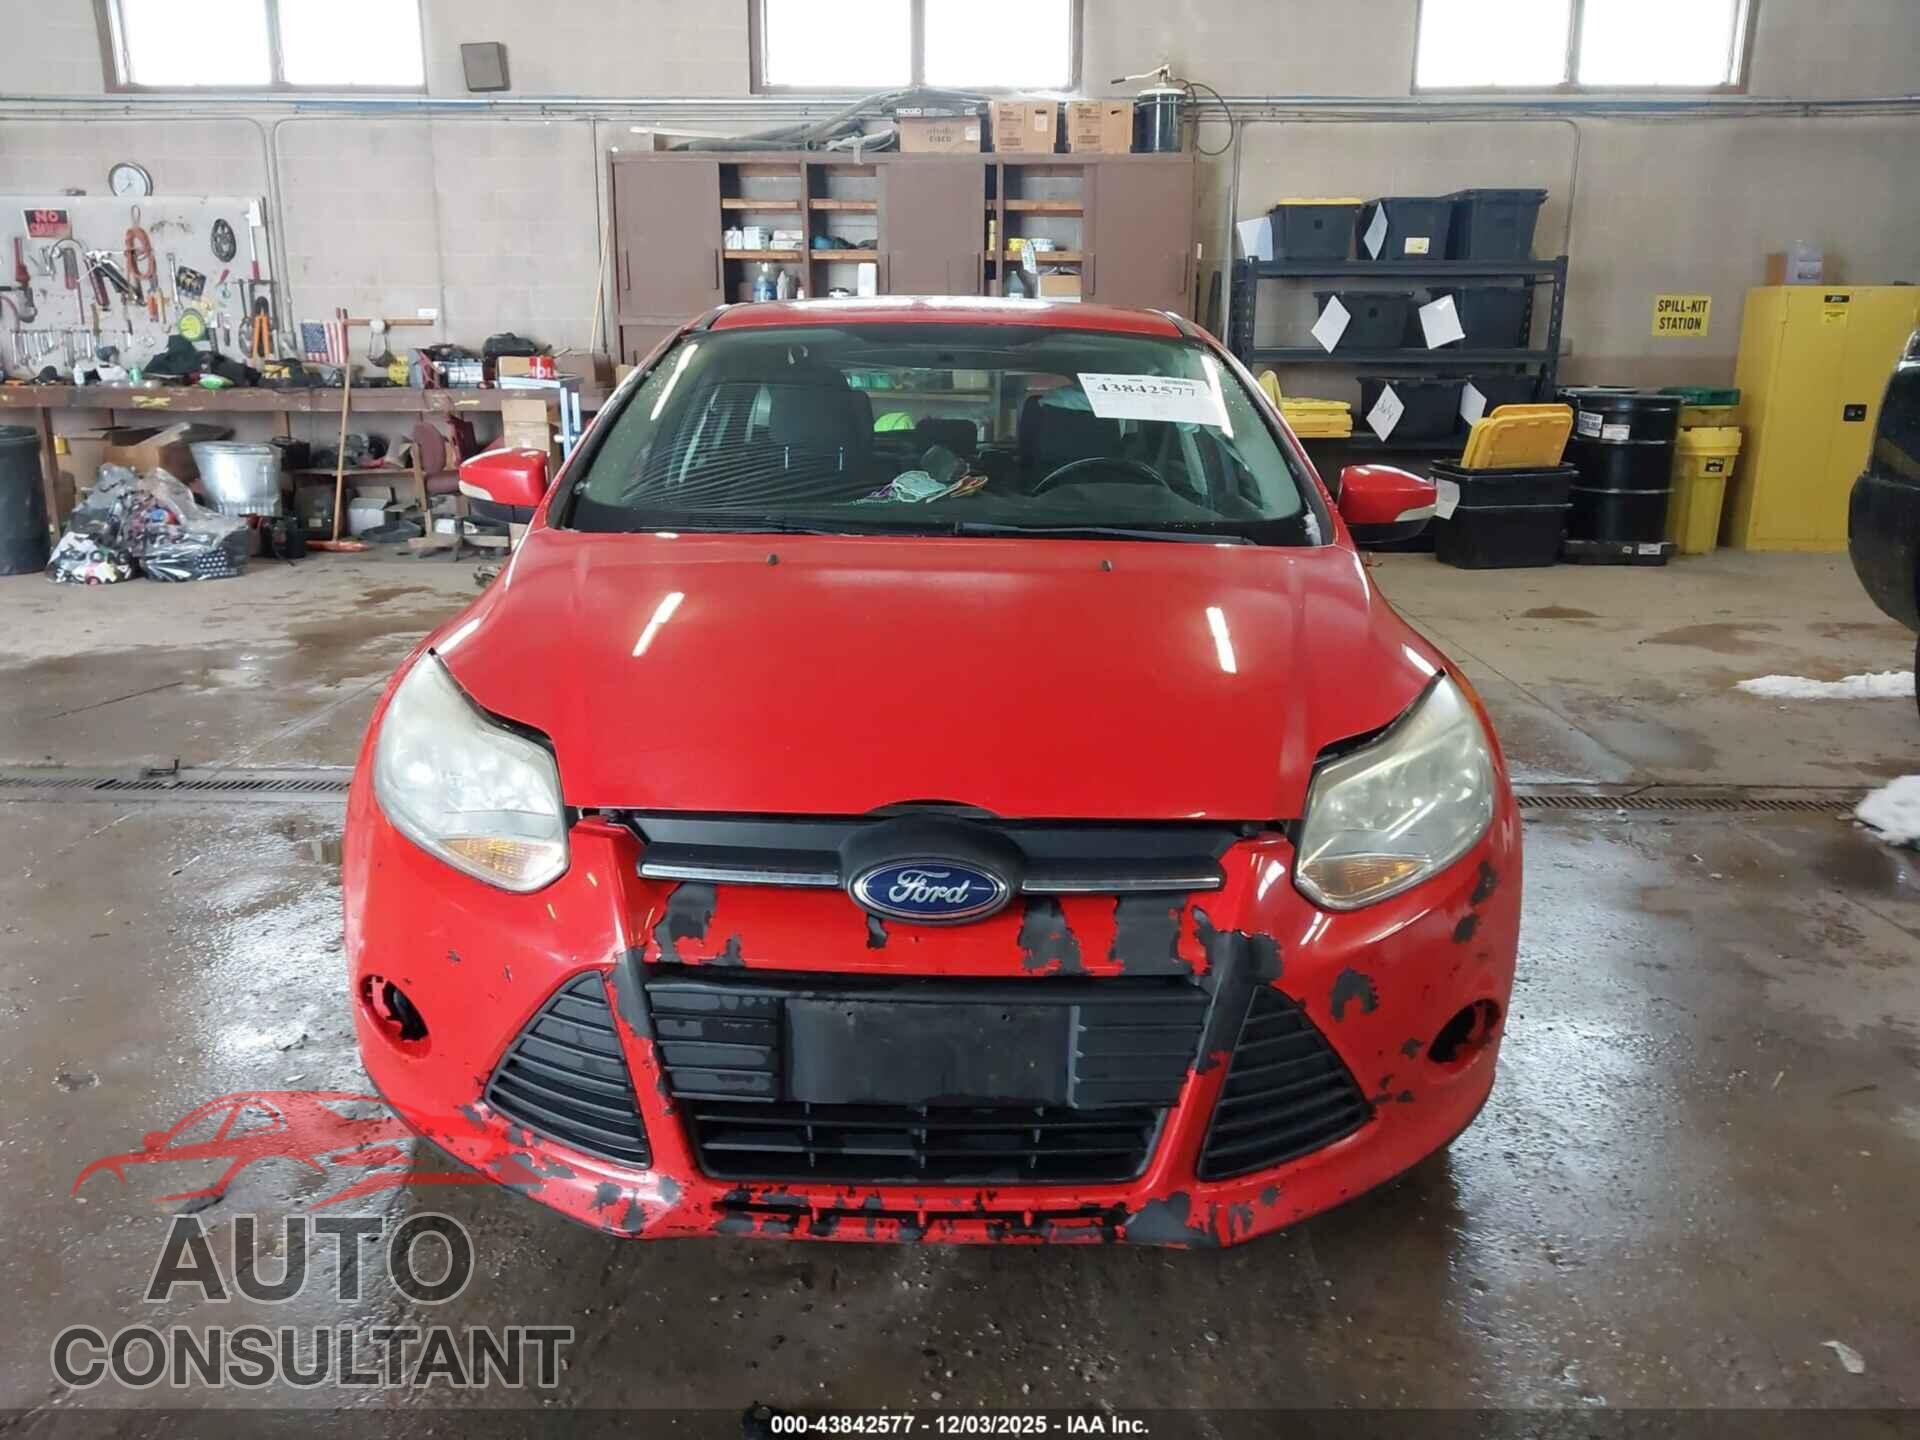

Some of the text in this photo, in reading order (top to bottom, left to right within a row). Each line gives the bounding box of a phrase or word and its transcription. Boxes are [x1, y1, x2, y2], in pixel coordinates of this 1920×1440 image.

[35, 211, 59, 222] NO
[1658, 300, 1708, 312] SPILL-KIT
[1659, 317, 1702, 329] STATION
[1097, 383, 1196, 396] 43842577
[888, 869, 970, 903] Ford
